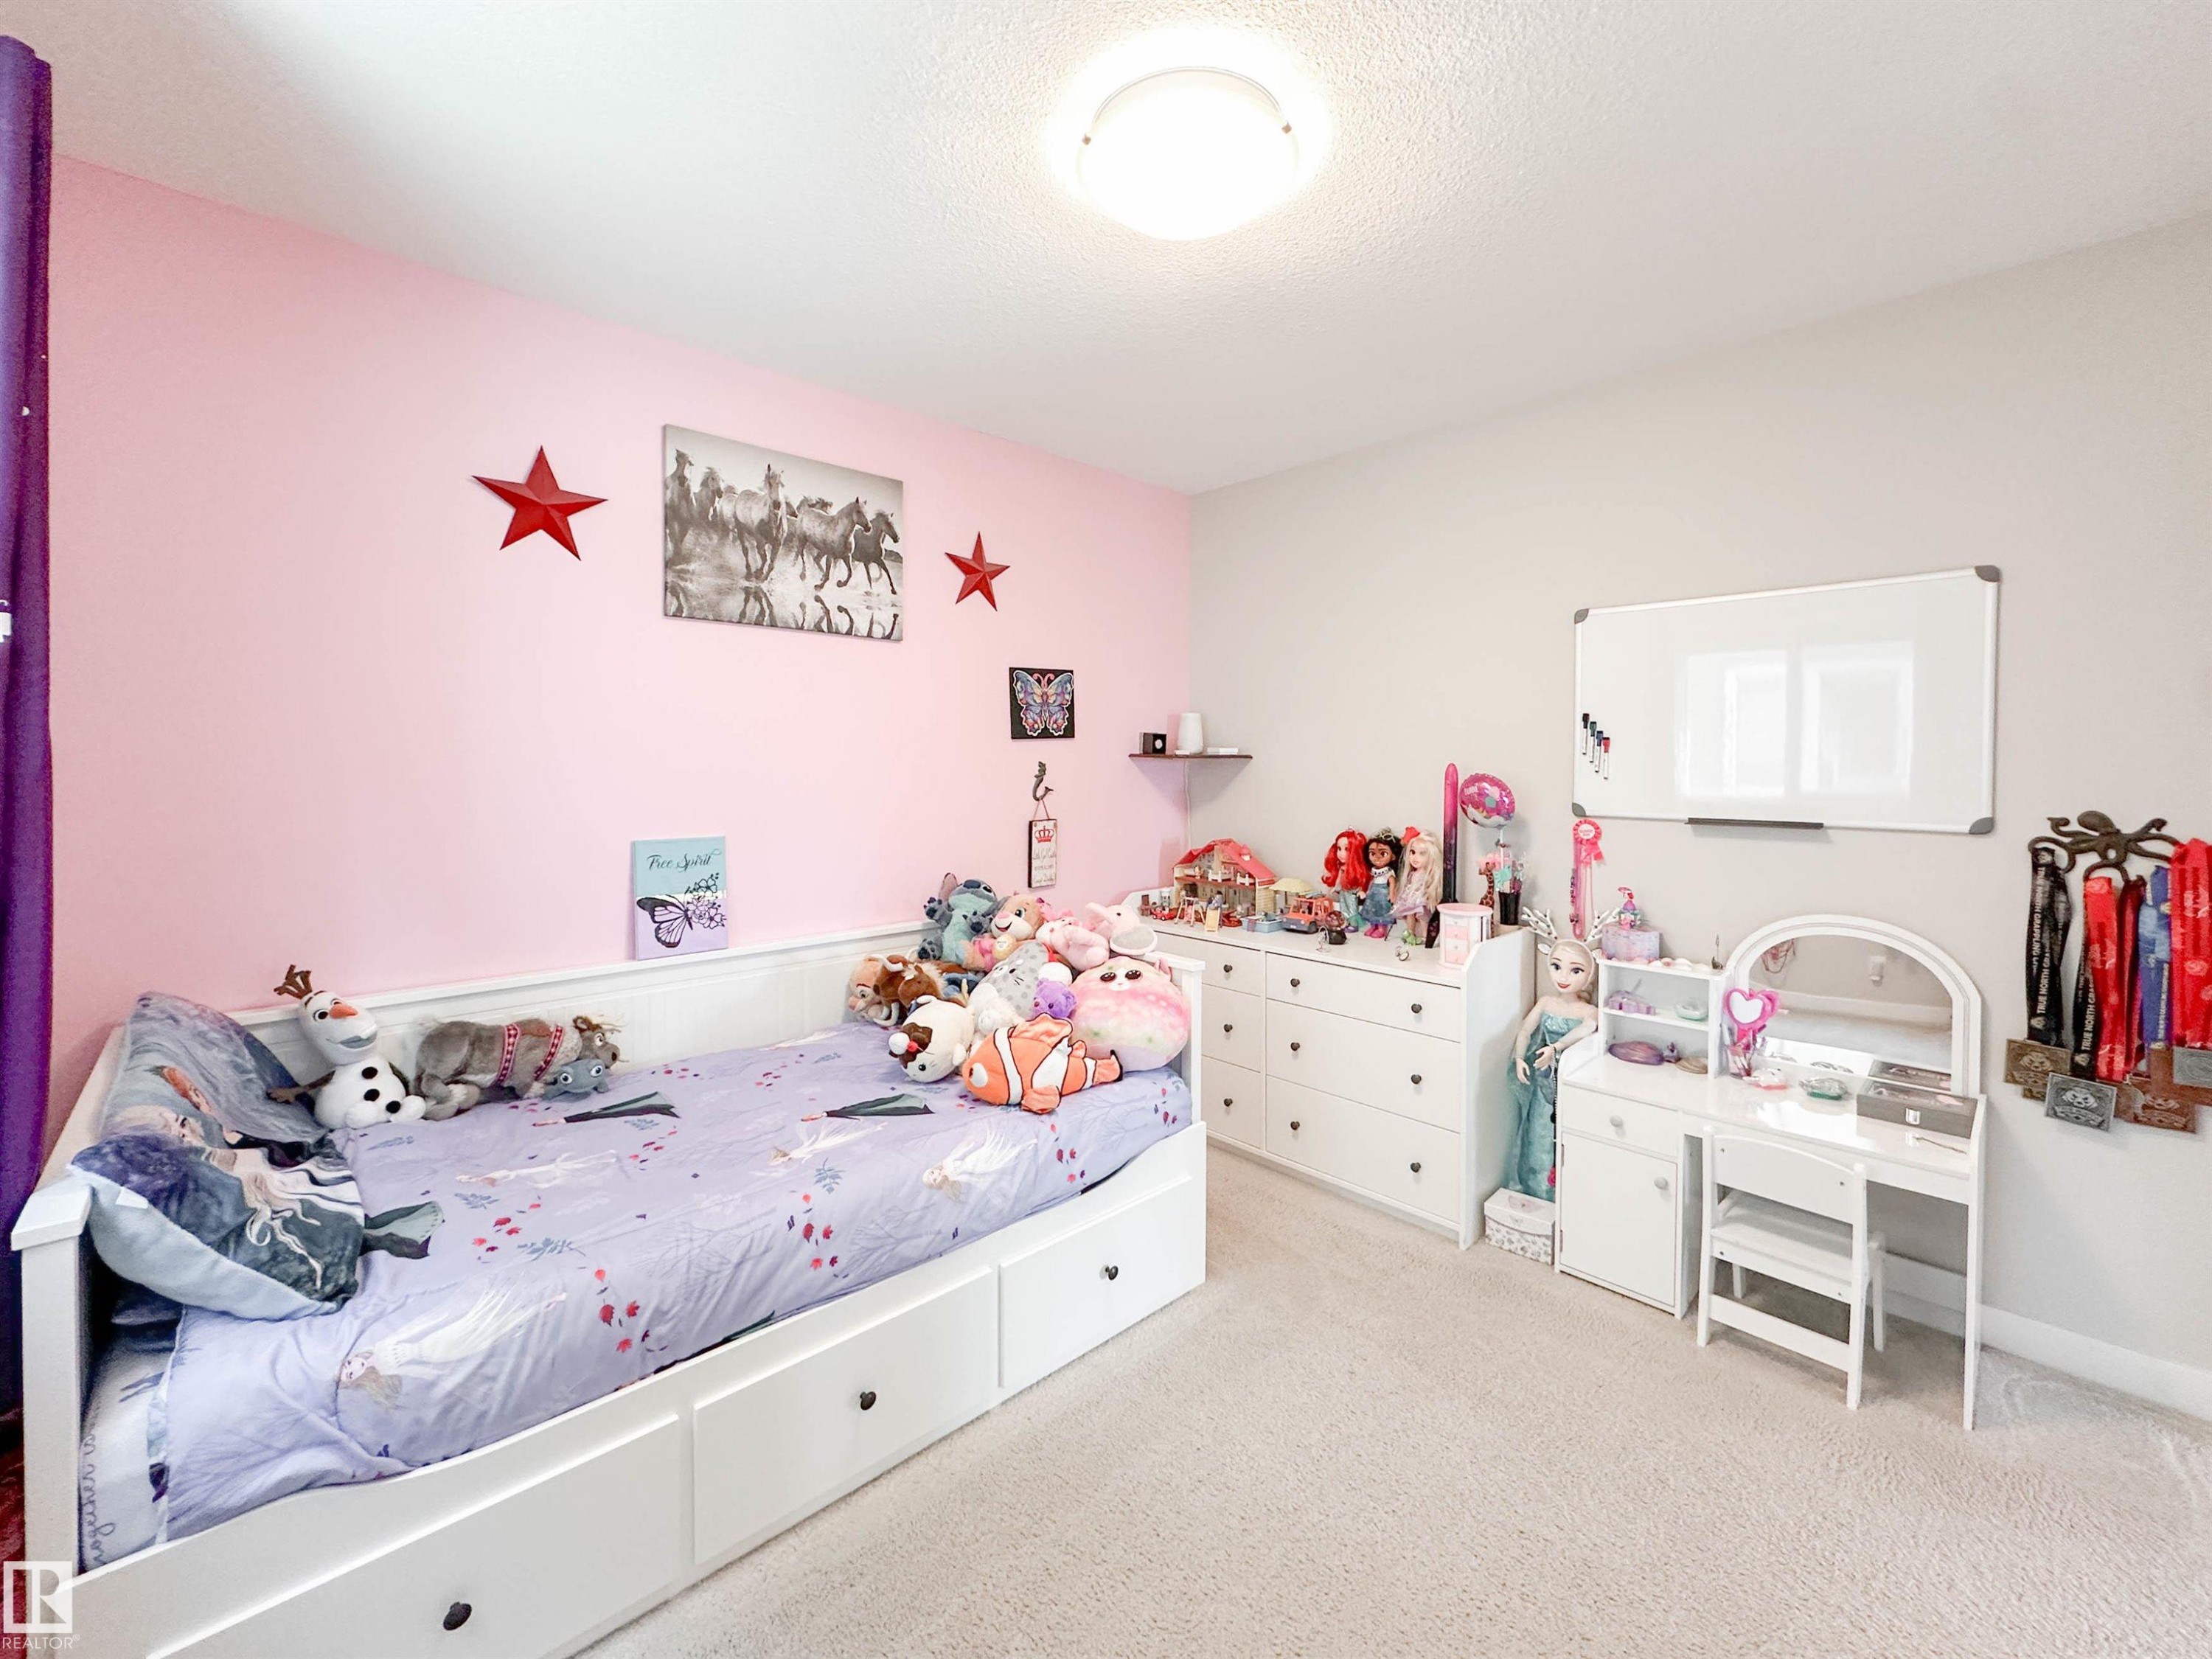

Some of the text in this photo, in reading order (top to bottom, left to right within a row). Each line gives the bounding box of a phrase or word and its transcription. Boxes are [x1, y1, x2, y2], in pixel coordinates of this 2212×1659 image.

[647, 849, 722, 873] Free Spirit
[2032, 914, 2042, 956] GRAPPLING
[2039, 969, 2050, 995] NORTH
[2037, 995, 2047, 1014] TRUE
[2084, 1004, 2095, 1031] NORTH
[2081, 1032, 2093, 1050] TRUE
